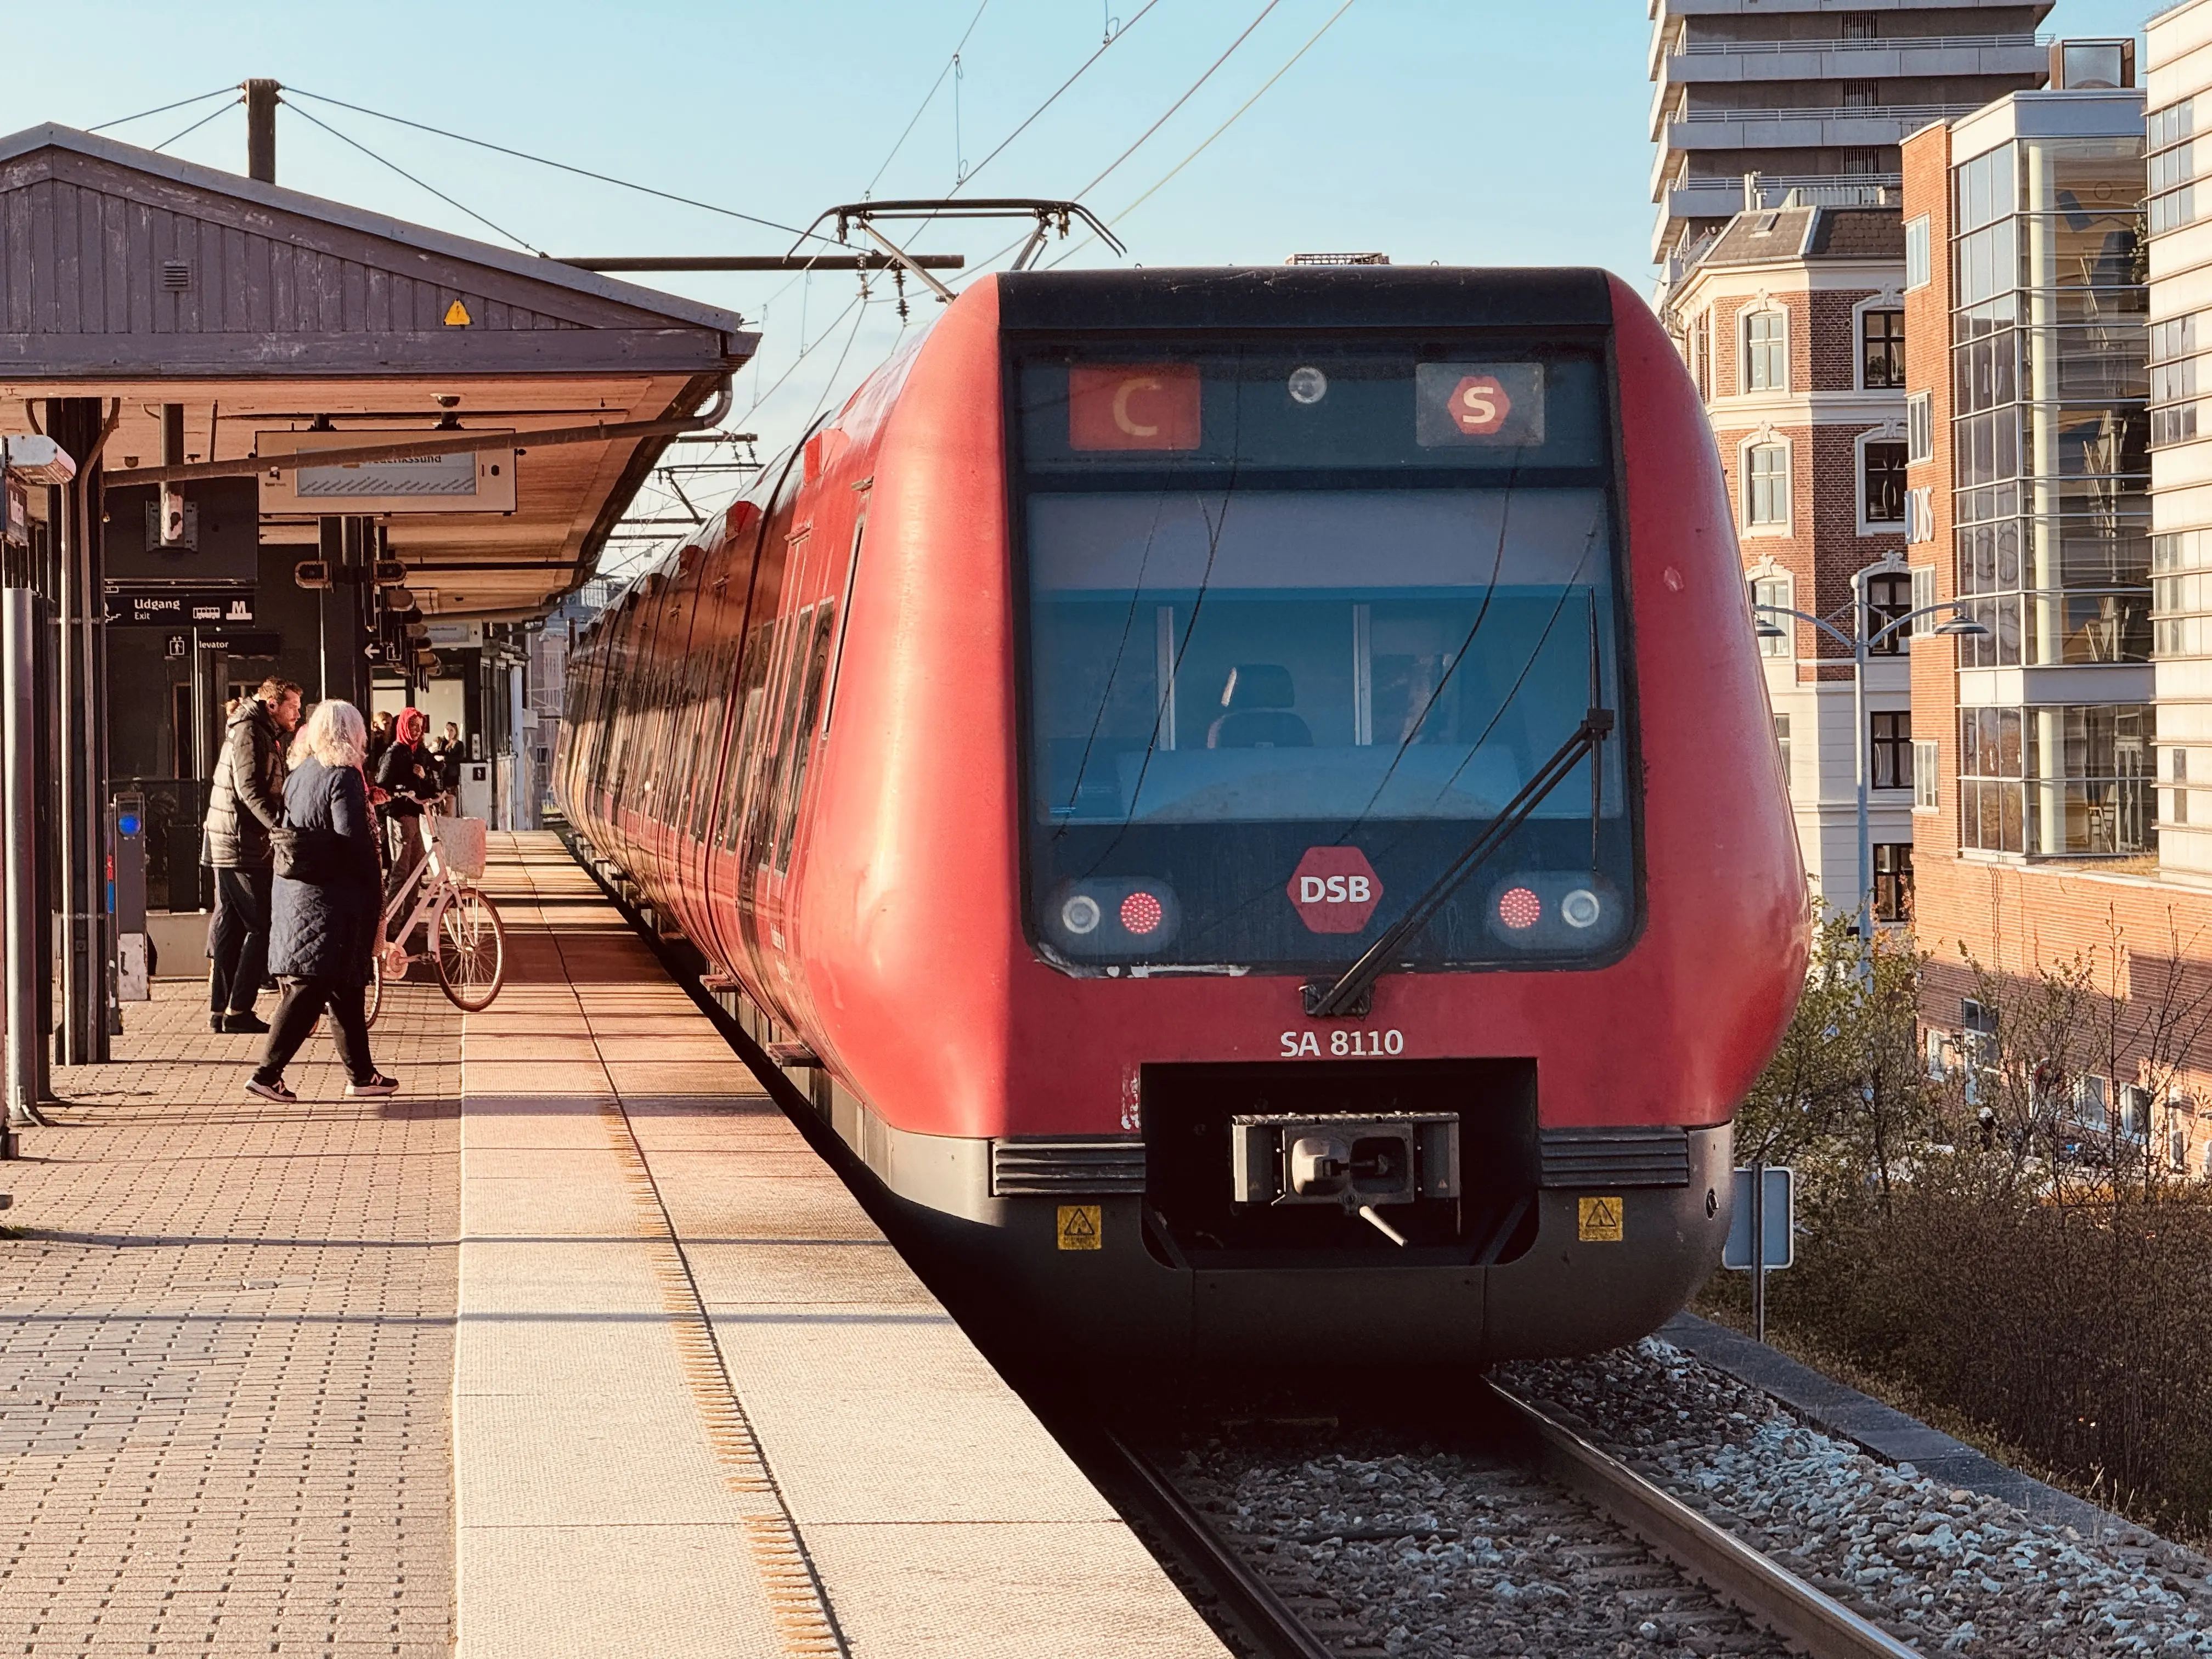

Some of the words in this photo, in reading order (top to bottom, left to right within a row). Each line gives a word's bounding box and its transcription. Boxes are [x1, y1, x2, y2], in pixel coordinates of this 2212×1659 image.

[1113, 377, 1159, 437] C
[1463, 386, 1496, 424] S
[134, 598, 180, 611] Udgang
[134, 611, 150, 620] Exit
[199, 640, 229, 649] levator
[1301, 876, 1371, 903] DSB
[1280, 1031, 1321, 1057] SA
[1330, 1029, 1404, 1057] 8110
